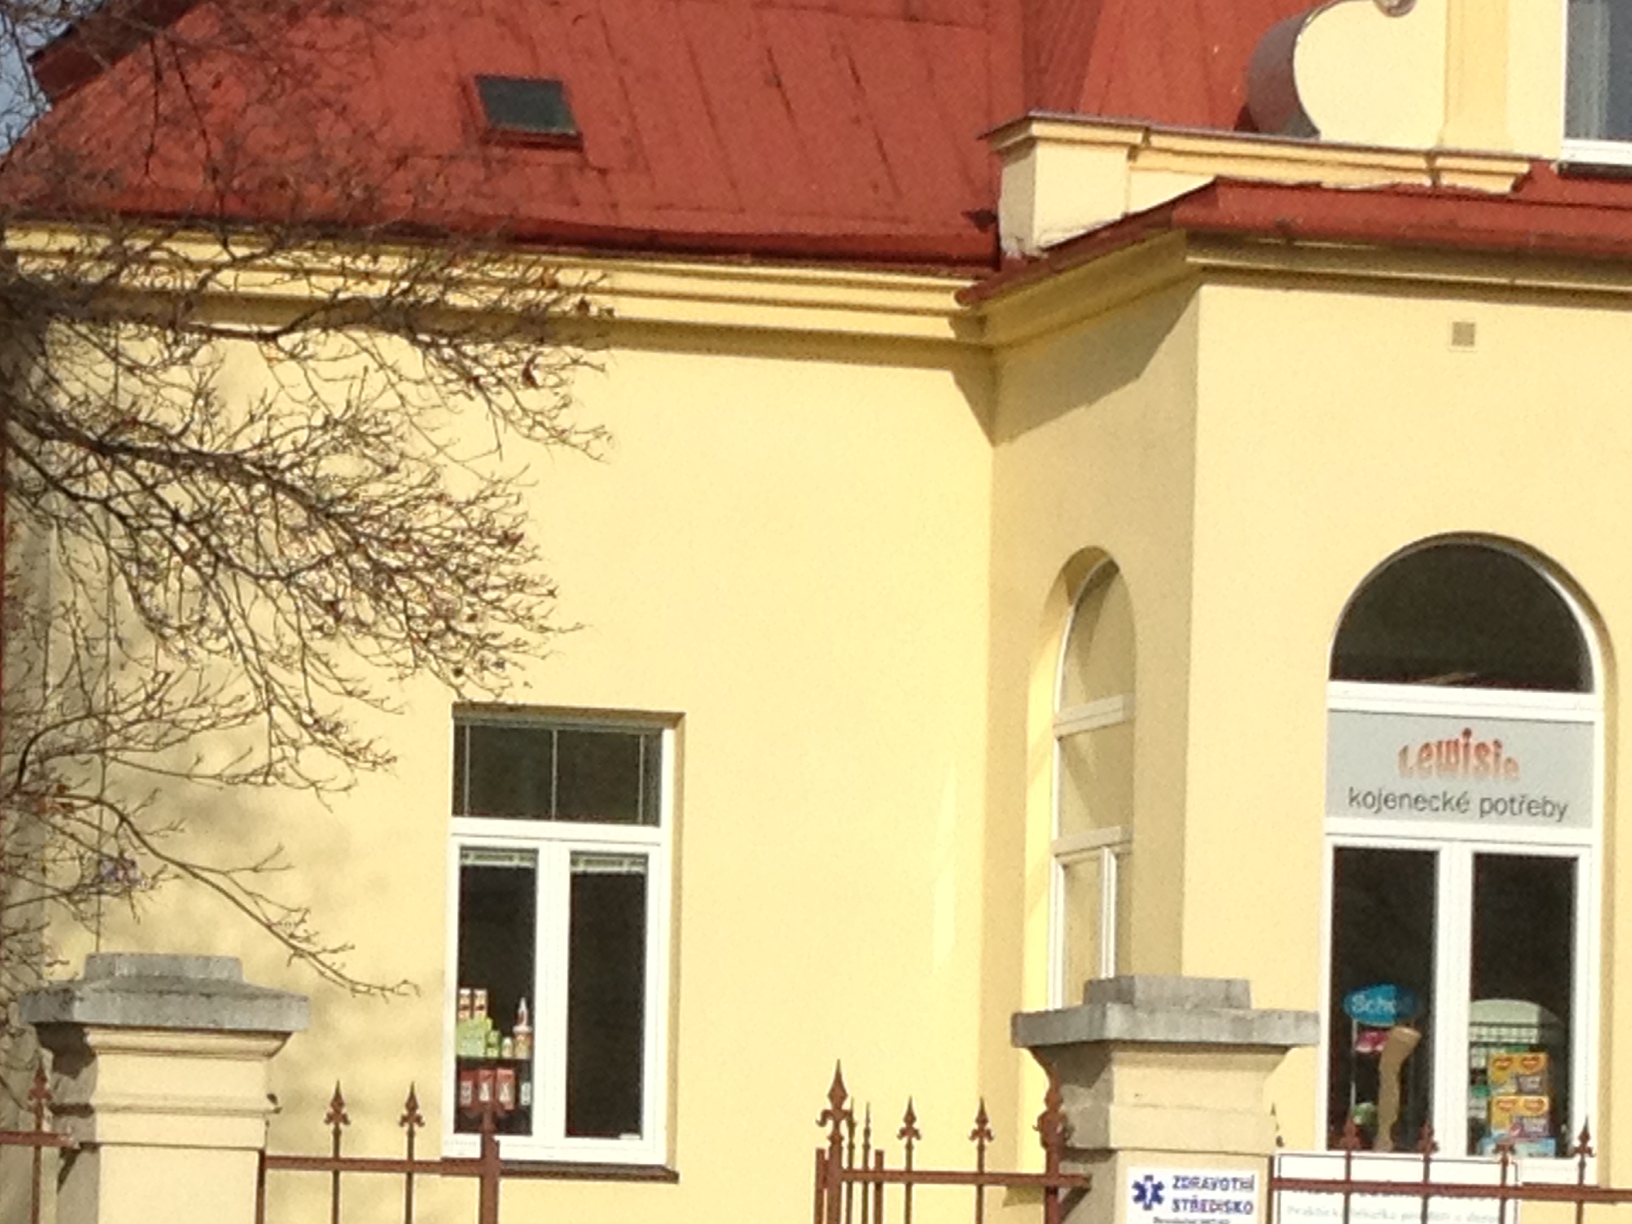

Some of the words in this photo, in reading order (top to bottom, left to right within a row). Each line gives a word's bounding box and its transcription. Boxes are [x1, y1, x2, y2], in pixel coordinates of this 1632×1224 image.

[1348, 786, 1470, 814] kojenecké
[1479, 793, 1569, 823] potřeby
[1172, 1195, 1254, 1215] STŘEDISKO
